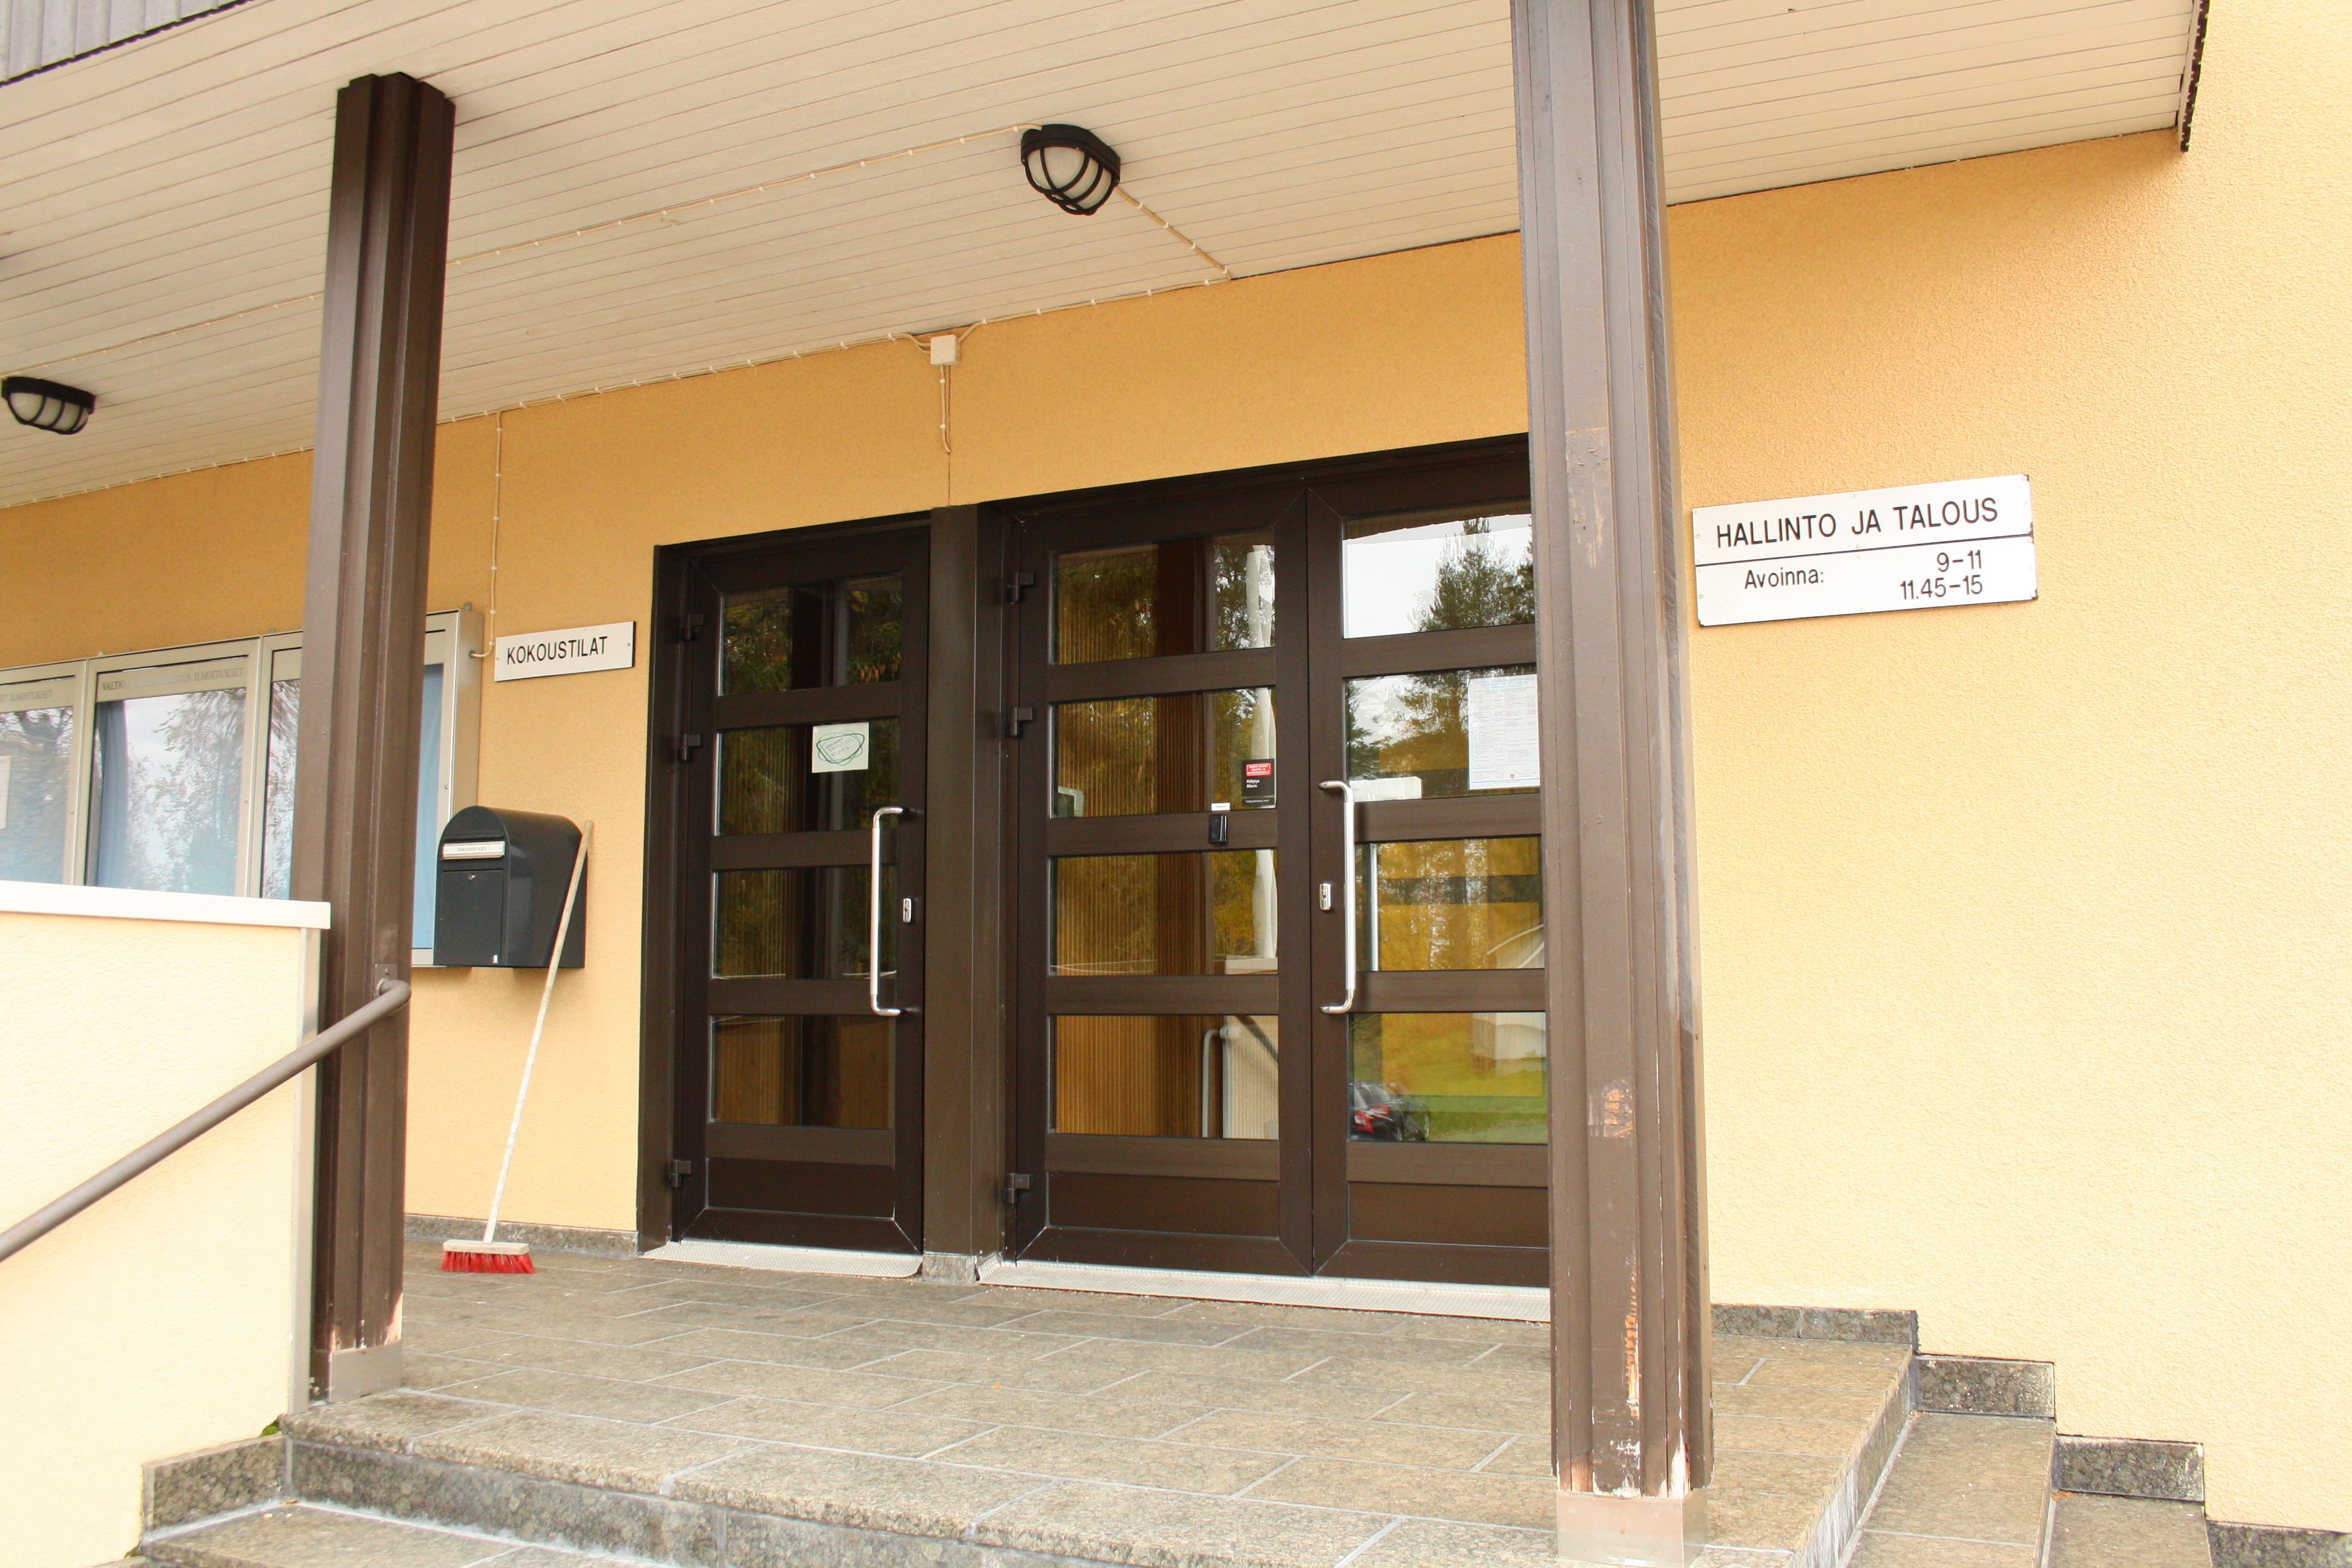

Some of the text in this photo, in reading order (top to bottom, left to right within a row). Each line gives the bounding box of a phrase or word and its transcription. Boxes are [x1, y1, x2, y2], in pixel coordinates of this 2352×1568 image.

[1717, 497, 1998, 548] HALLINTO JA TALOUS
[1936, 549, 1982, 572] 9-11
[1745, 567, 1824, 590] Avoinna:
[1900, 574, 1983, 600] 11.45-15
[507, 636, 608, 665] KOKOUSTILAT
[827, 737, 853, 752] savuton
[830, 746, 850, 757] kunta
